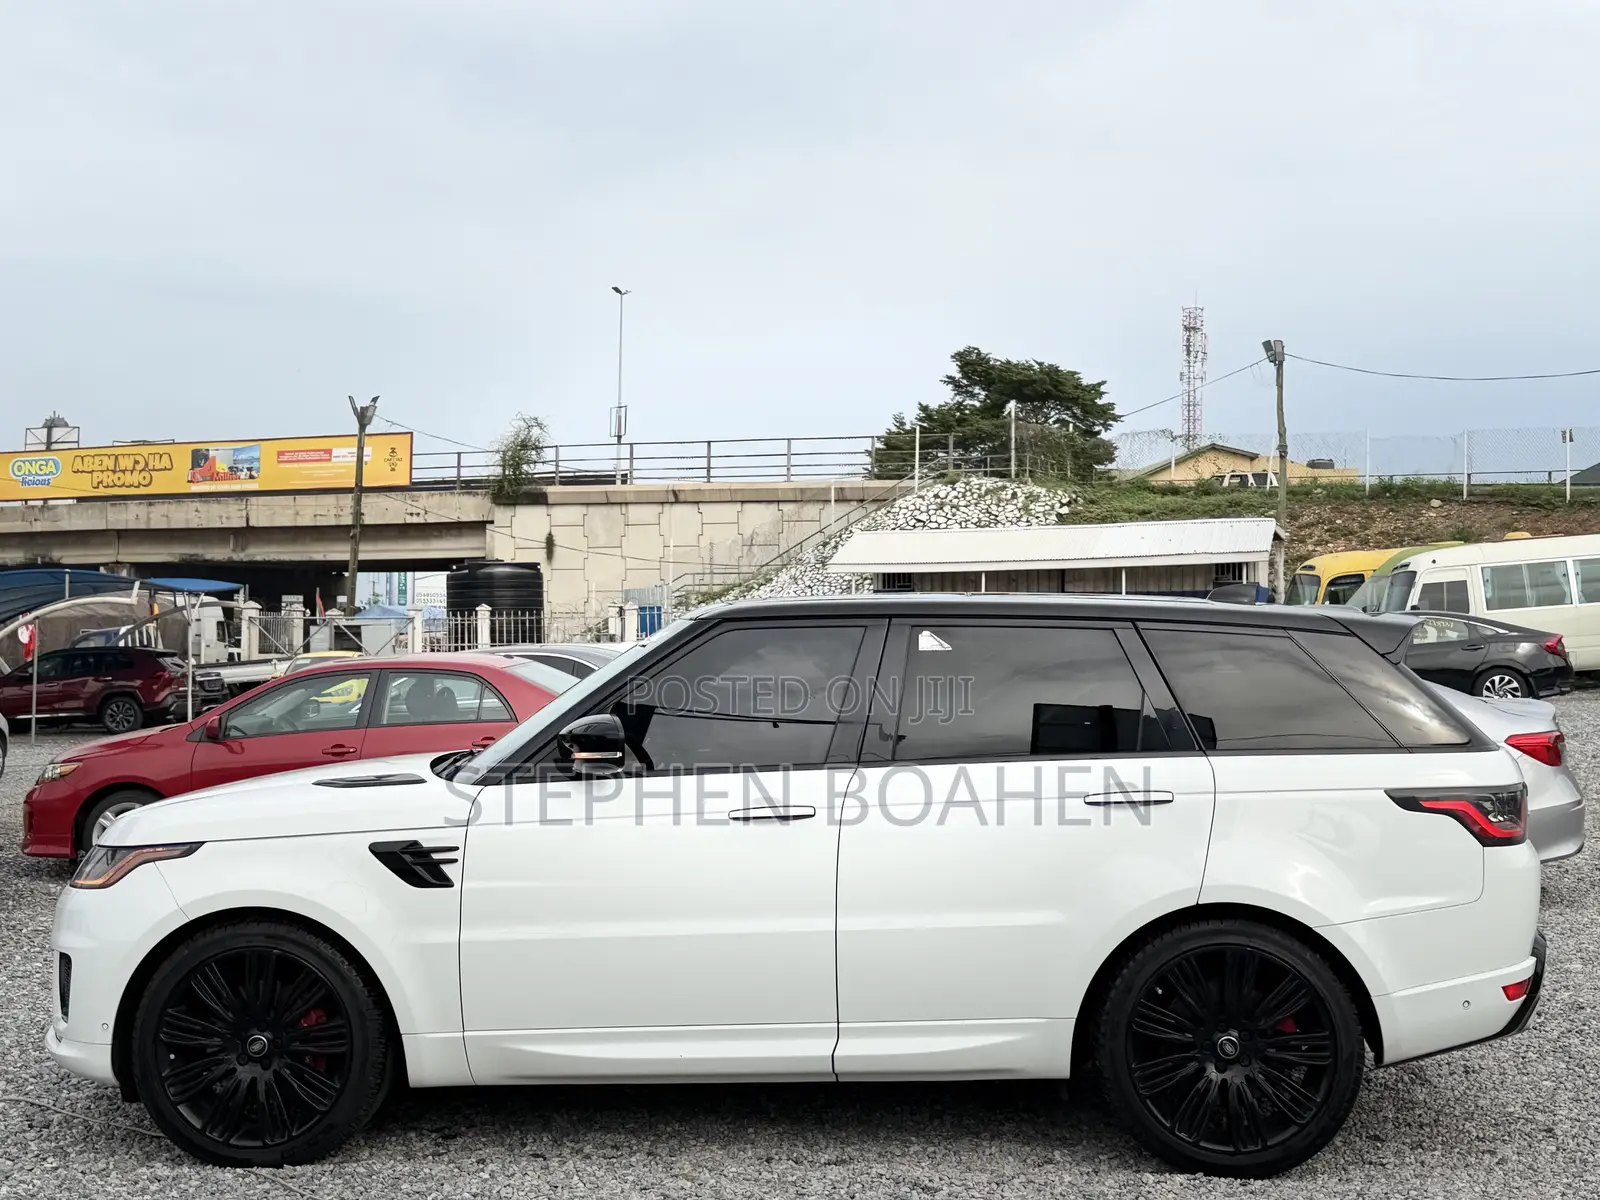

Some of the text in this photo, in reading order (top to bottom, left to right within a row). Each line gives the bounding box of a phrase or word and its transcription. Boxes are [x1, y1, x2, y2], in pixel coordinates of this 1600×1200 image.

[13, 459, 57, 476] ONGA
[72, 455, 115, 472] ABEN
[148, 453, 173, 470] HA
[20, 477, 51, 487] licious
[91, 470, 152, 488] PROMO
